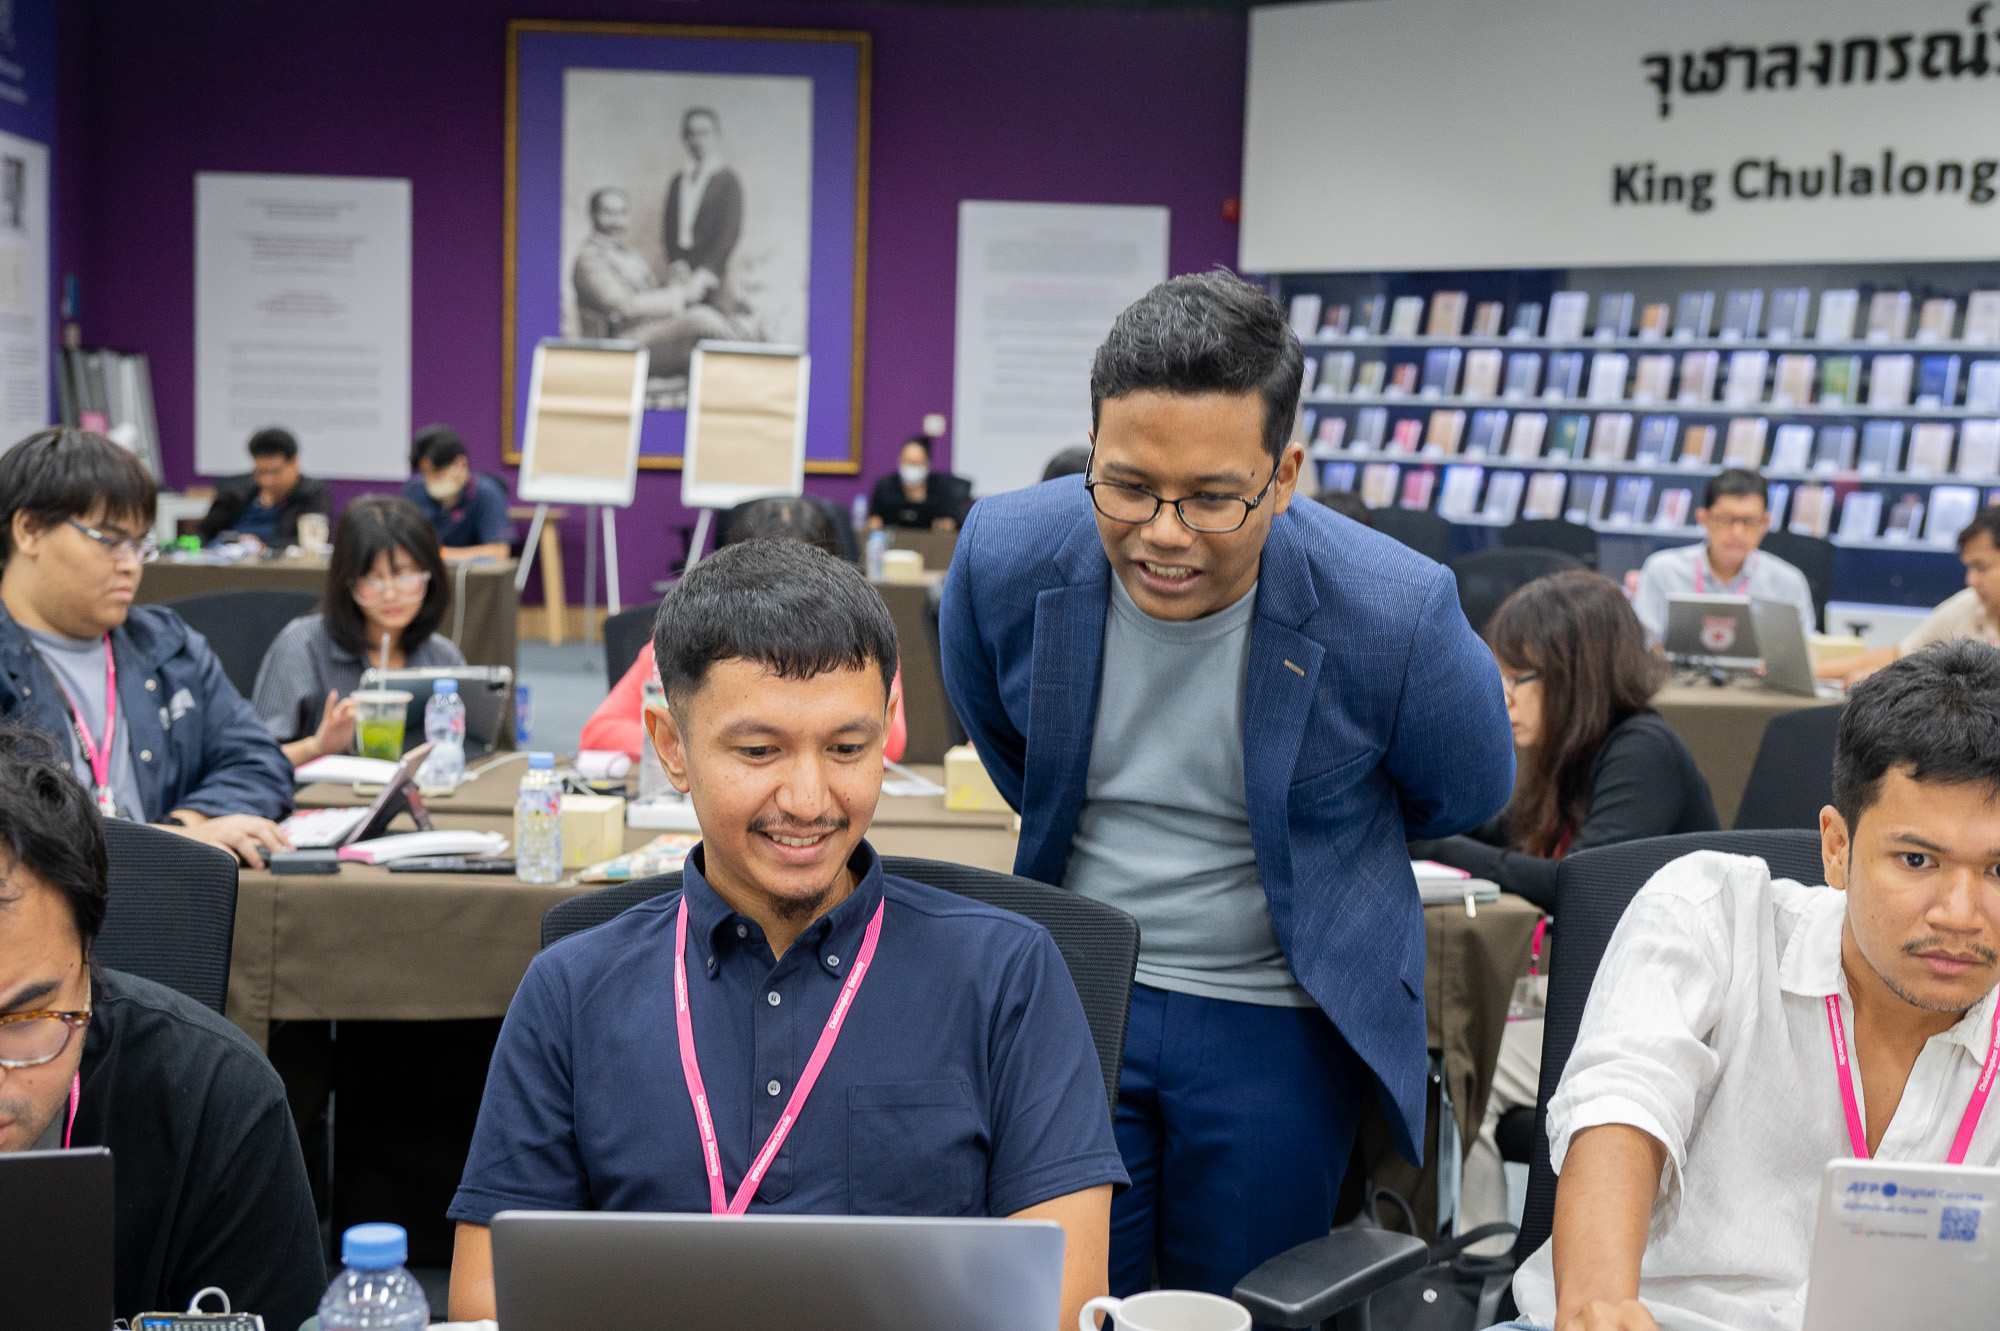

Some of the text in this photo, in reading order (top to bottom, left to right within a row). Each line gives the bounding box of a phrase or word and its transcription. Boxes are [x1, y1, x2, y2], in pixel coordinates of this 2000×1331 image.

[1641, 2, 2000, 119] จุฬาลงกรณ์
[1613, 149, 2000, 214] King Chulalong
[1847, 1181, 1880, 1194] AFP
[1900, 1187, 1936, 1199] Digital
